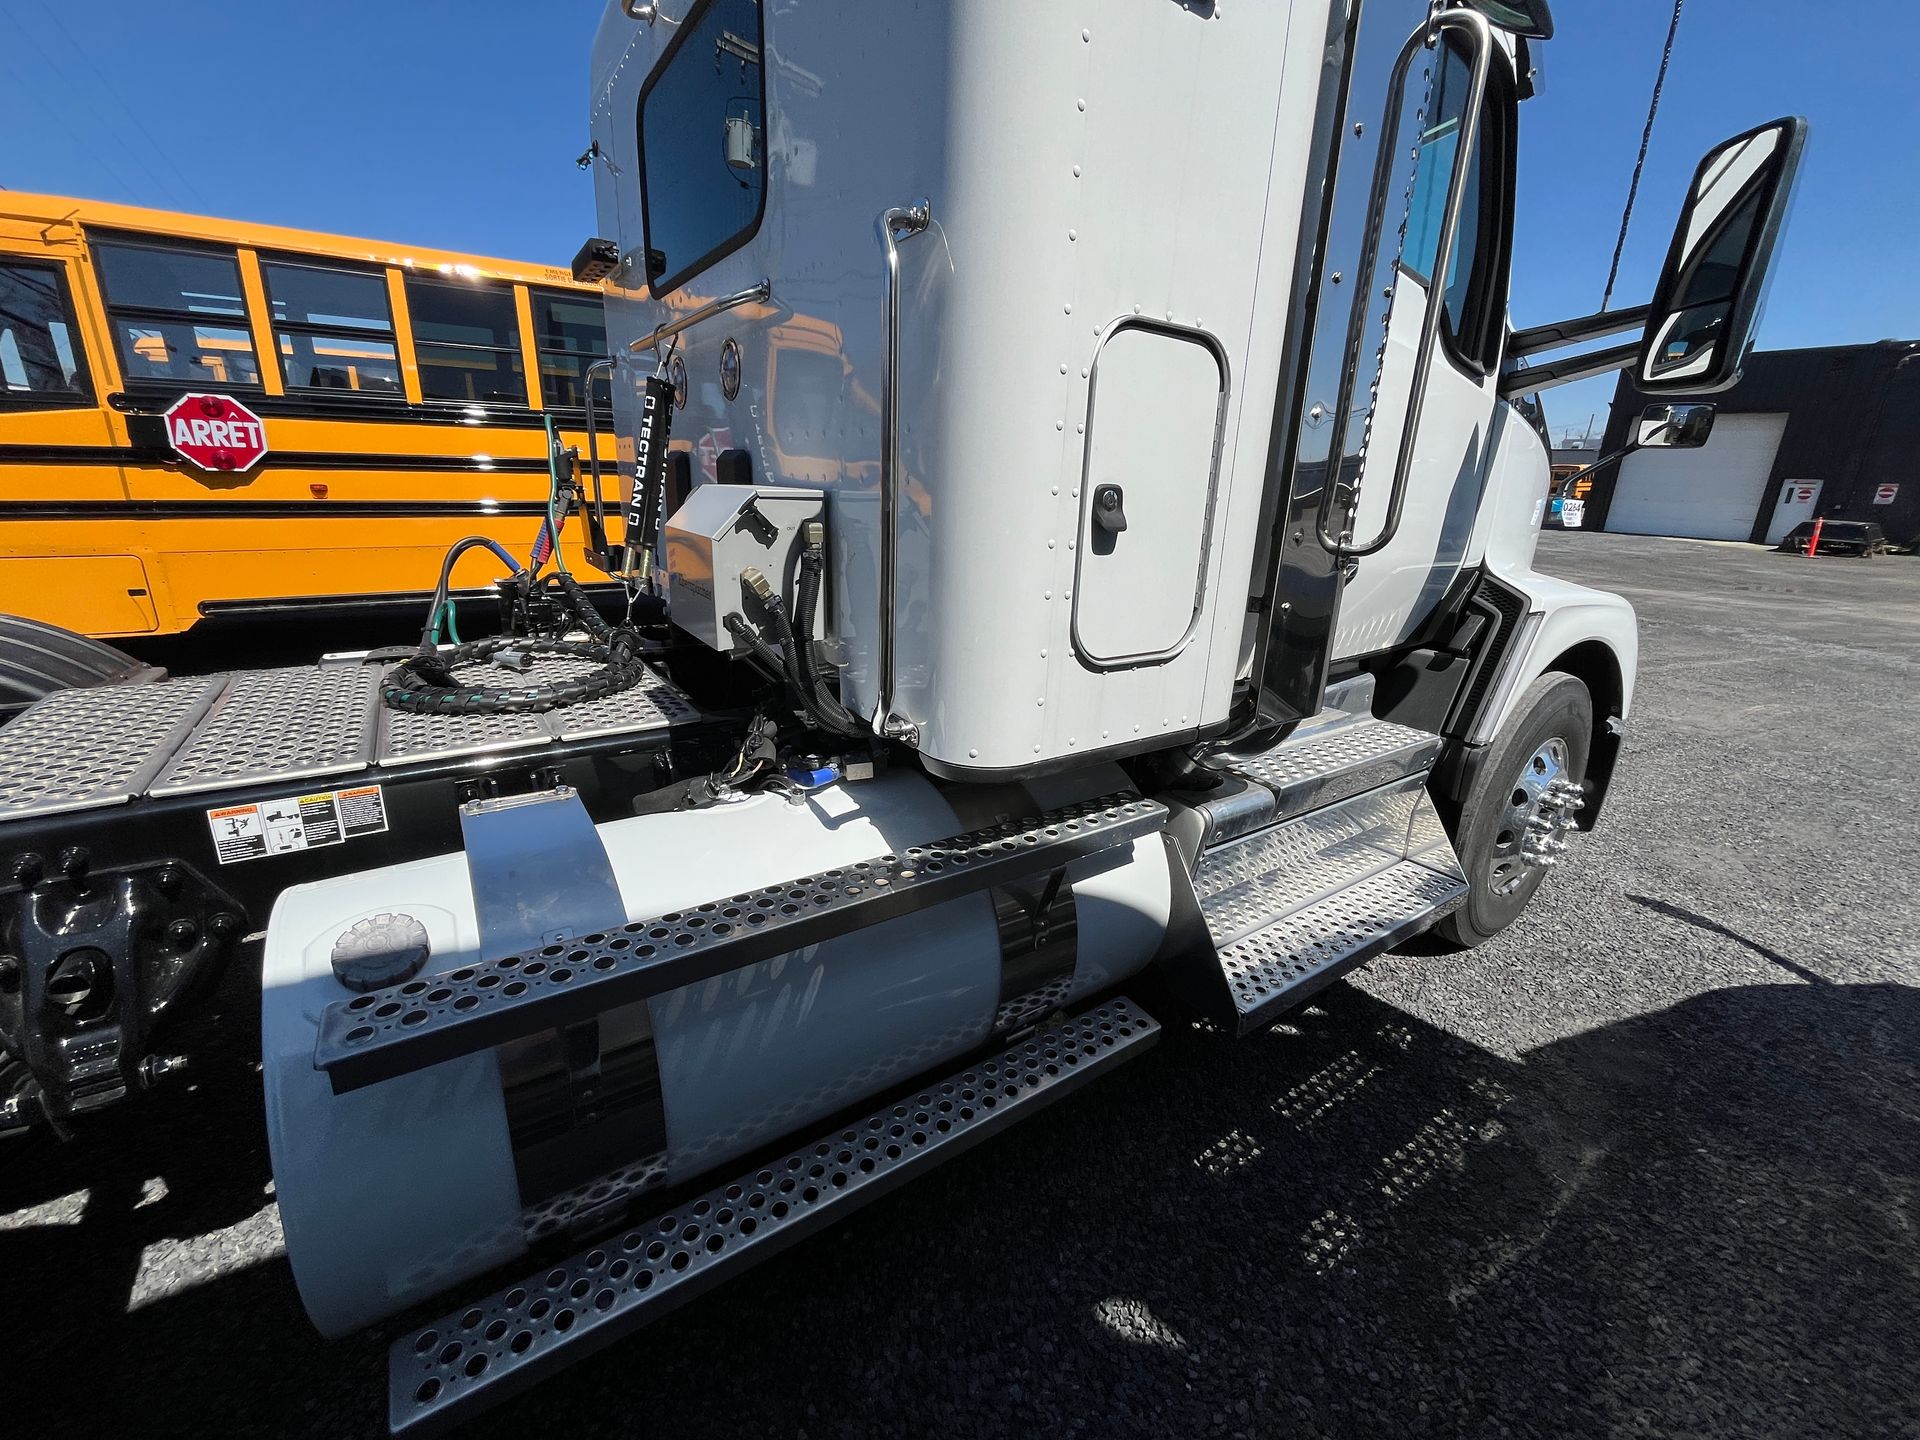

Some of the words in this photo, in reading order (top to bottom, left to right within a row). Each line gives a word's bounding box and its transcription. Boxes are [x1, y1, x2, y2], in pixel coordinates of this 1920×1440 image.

[175, 411, 260, 449] ARRÊT
[631, 415, 653, 508] TECTRAN
[220, 807, 253, 815] WARNING
